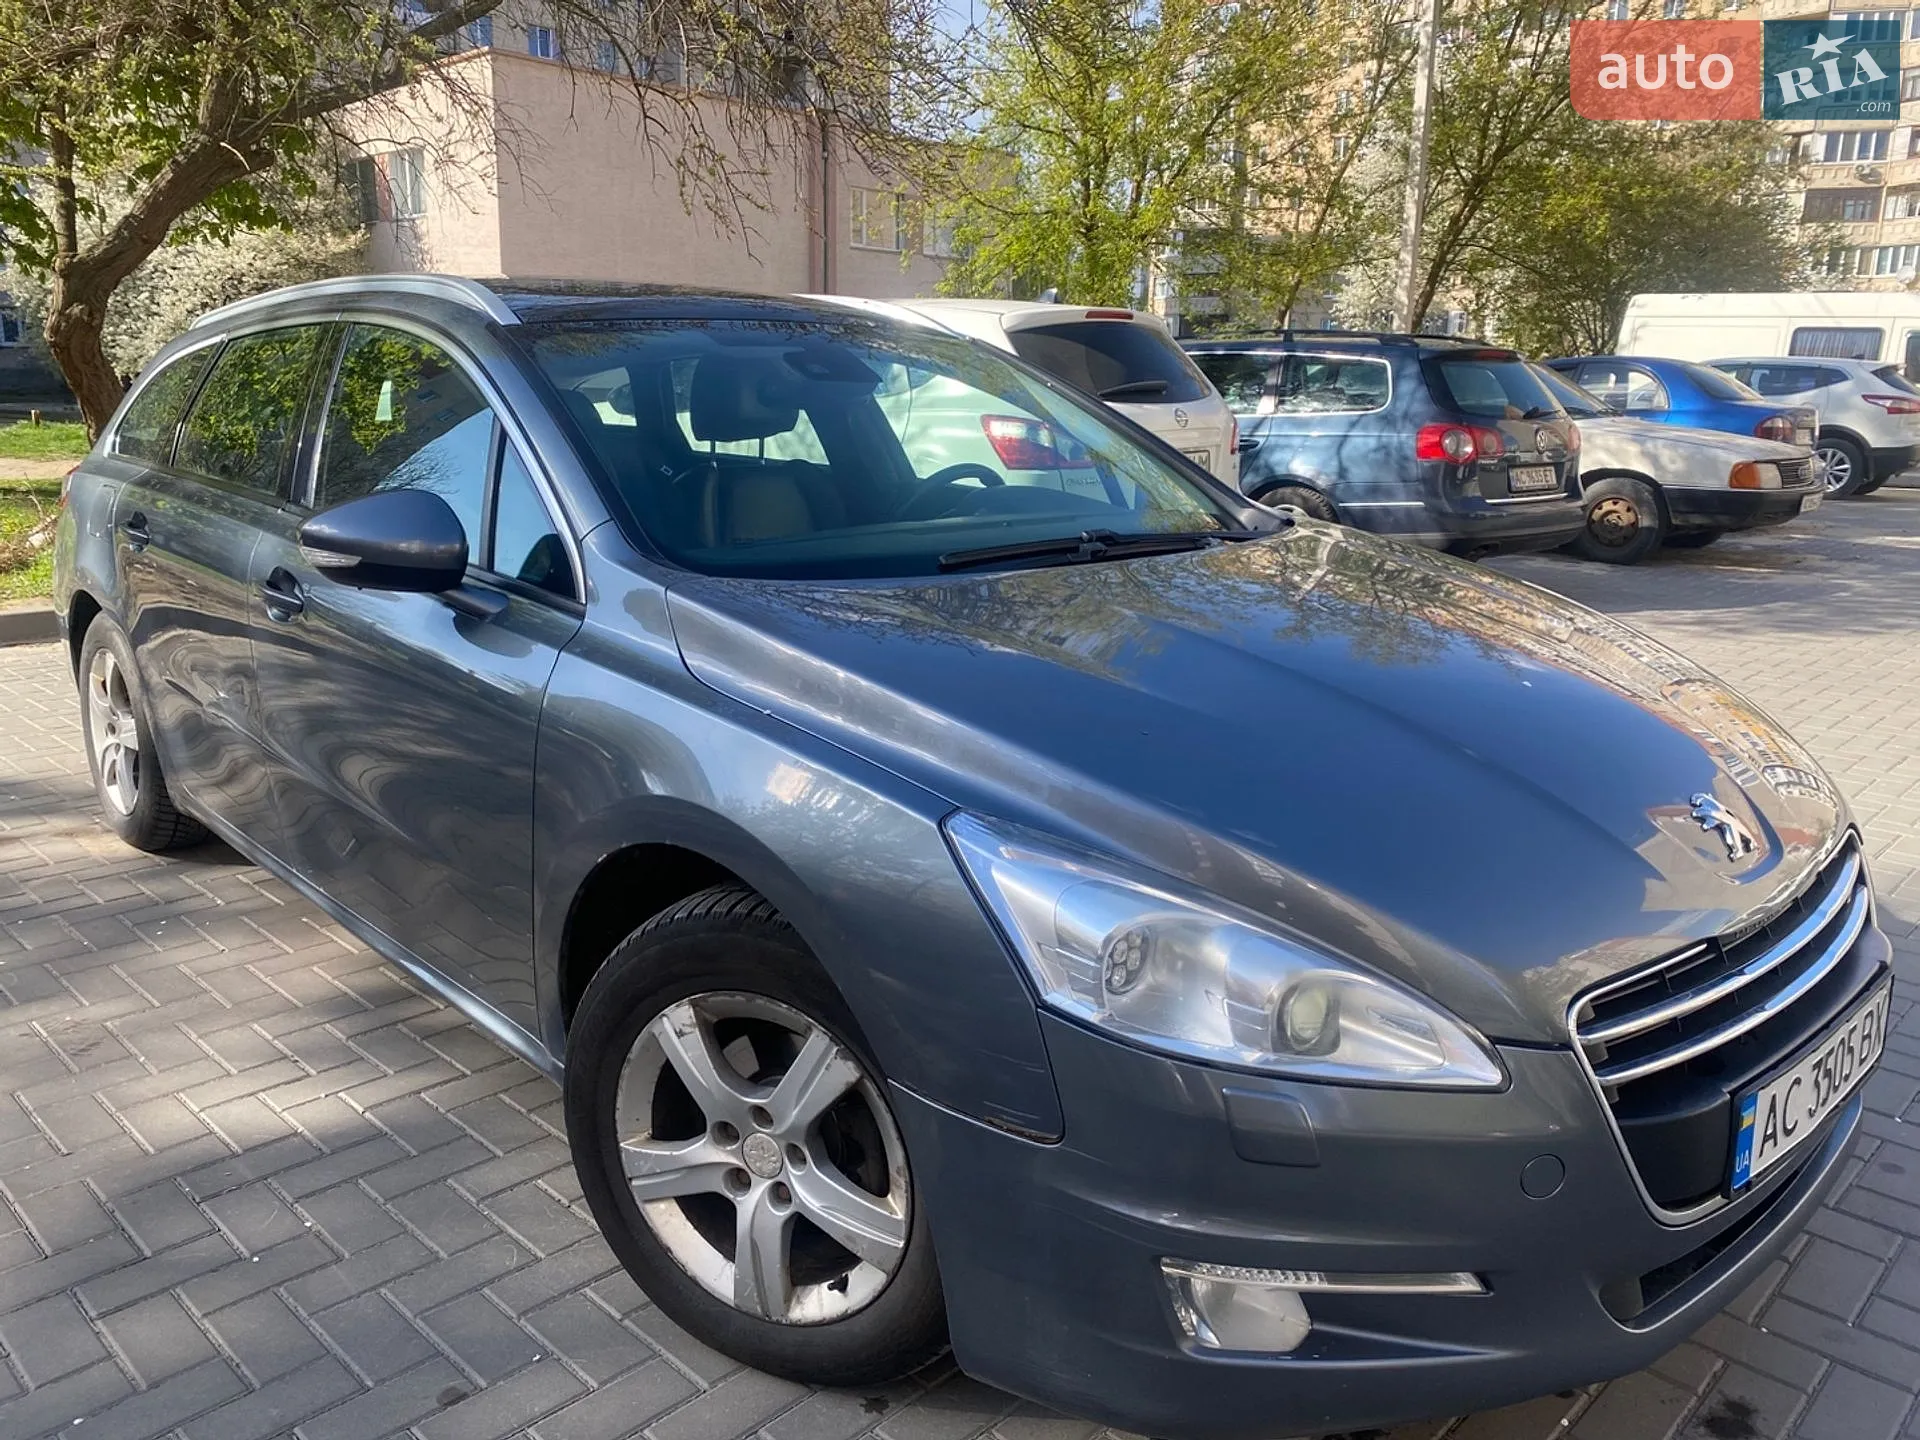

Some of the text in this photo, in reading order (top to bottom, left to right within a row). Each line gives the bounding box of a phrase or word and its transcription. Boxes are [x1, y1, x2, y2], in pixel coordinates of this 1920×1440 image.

[1759, 993, 1888, 1158] AC 3505 BX
[1735, 1150, 1749, 1173] UA
